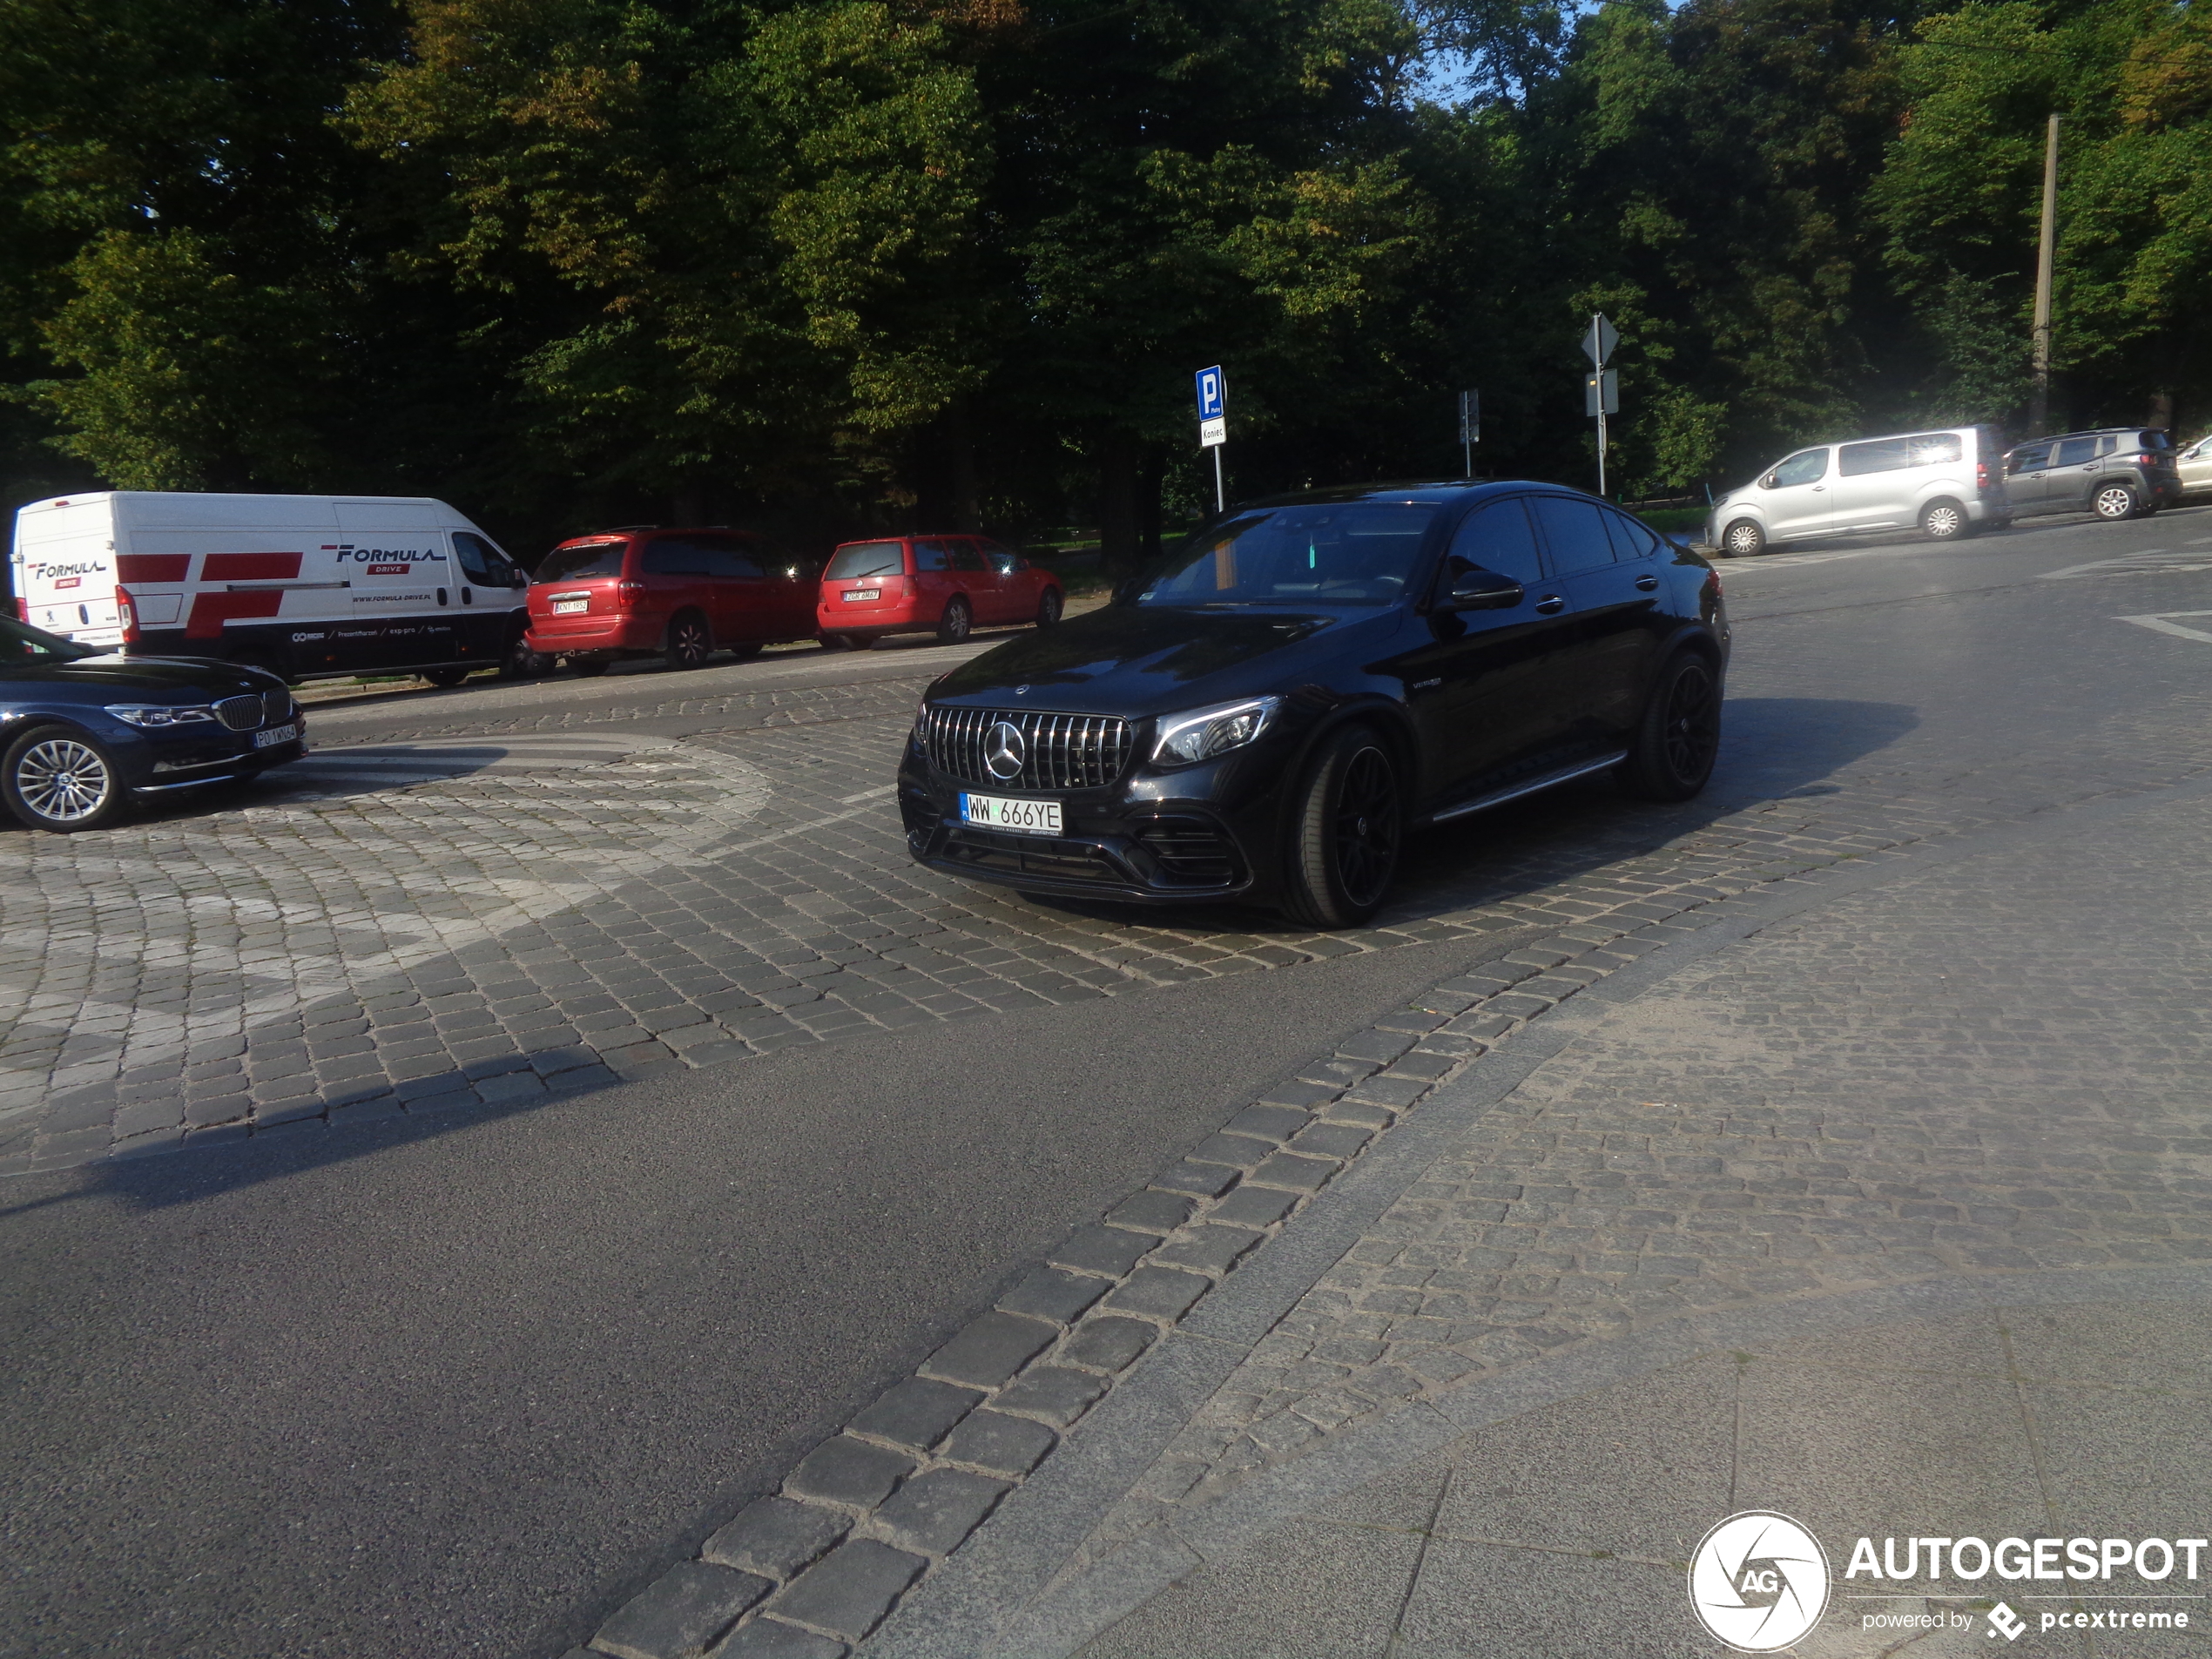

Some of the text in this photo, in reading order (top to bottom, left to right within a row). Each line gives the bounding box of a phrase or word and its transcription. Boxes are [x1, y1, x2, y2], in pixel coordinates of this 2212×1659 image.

[1203, 374, 1217, 415] P
[1204, 427, 1223, 439] Koniec
[336, 544, 447, 563] FORMULA
[37, 560, 106, 579] FORMULA
[353, 594, 431, 603] WWW.FORMULA-DRIVE.PL
[968, 796, 1060, 828] WW 666YE
